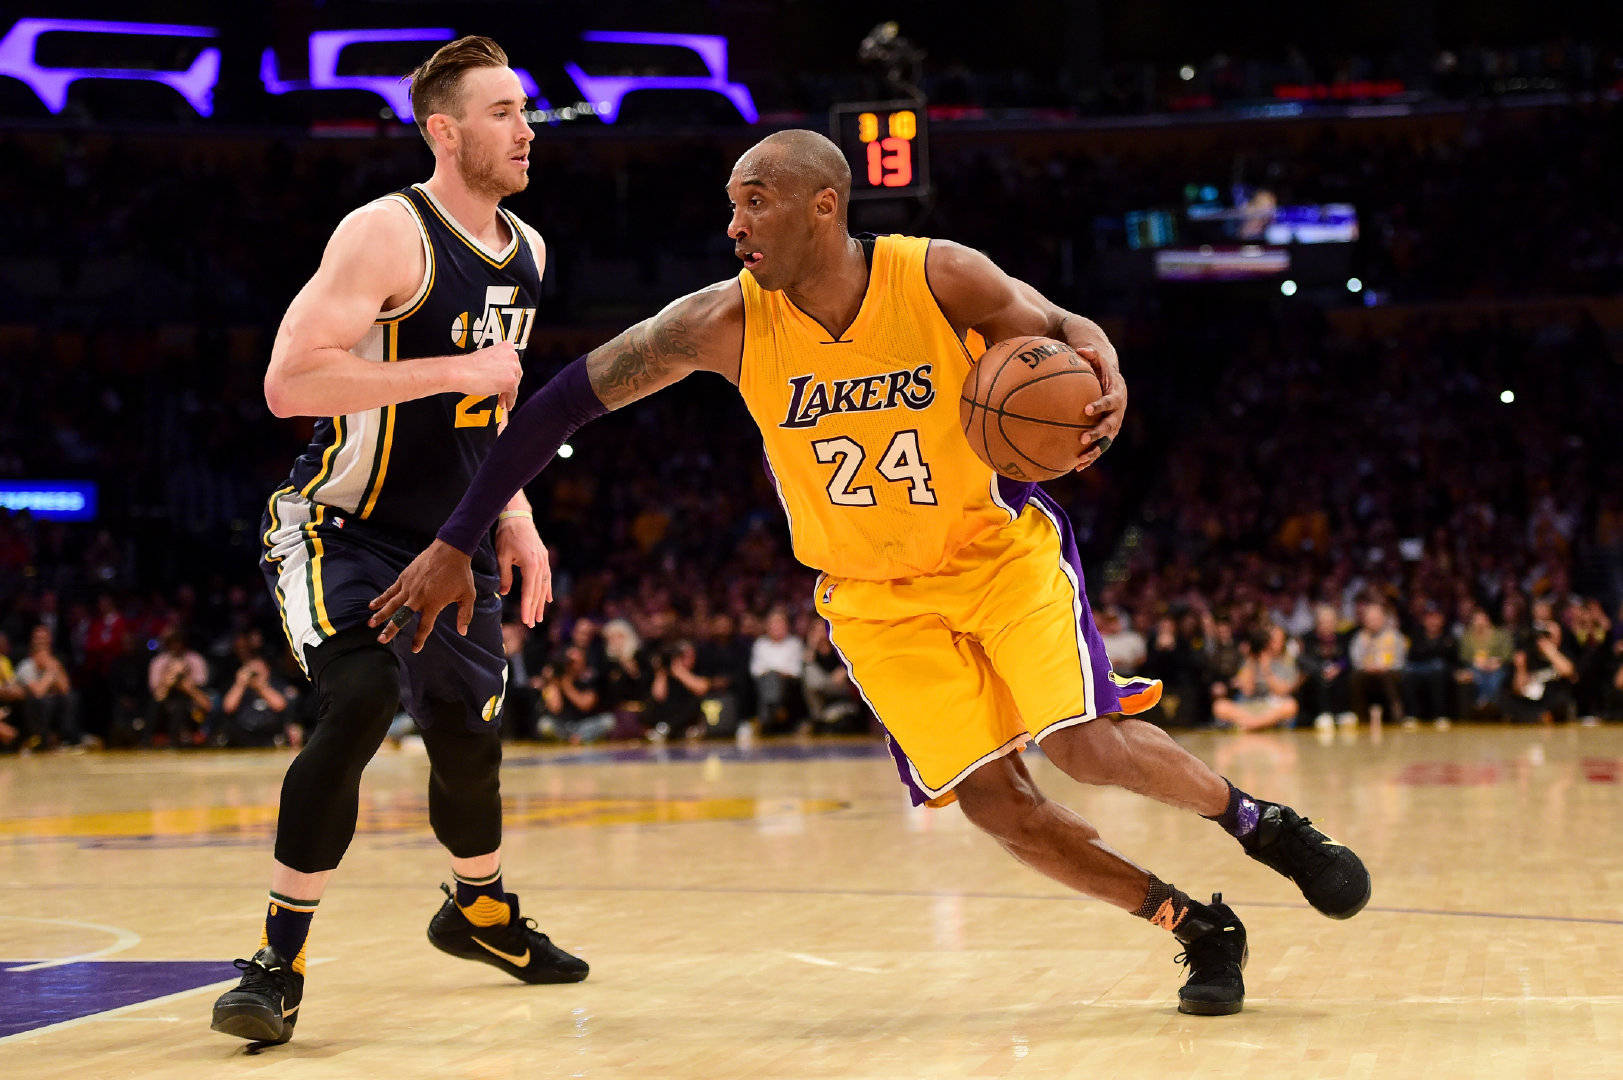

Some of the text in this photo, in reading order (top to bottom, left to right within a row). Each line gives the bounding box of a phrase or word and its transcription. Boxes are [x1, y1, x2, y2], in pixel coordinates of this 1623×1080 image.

[867, 137, 912, 187] 13
[778, 364, 936, 430] LAKERS
[811, 429, 938, 508] 24
